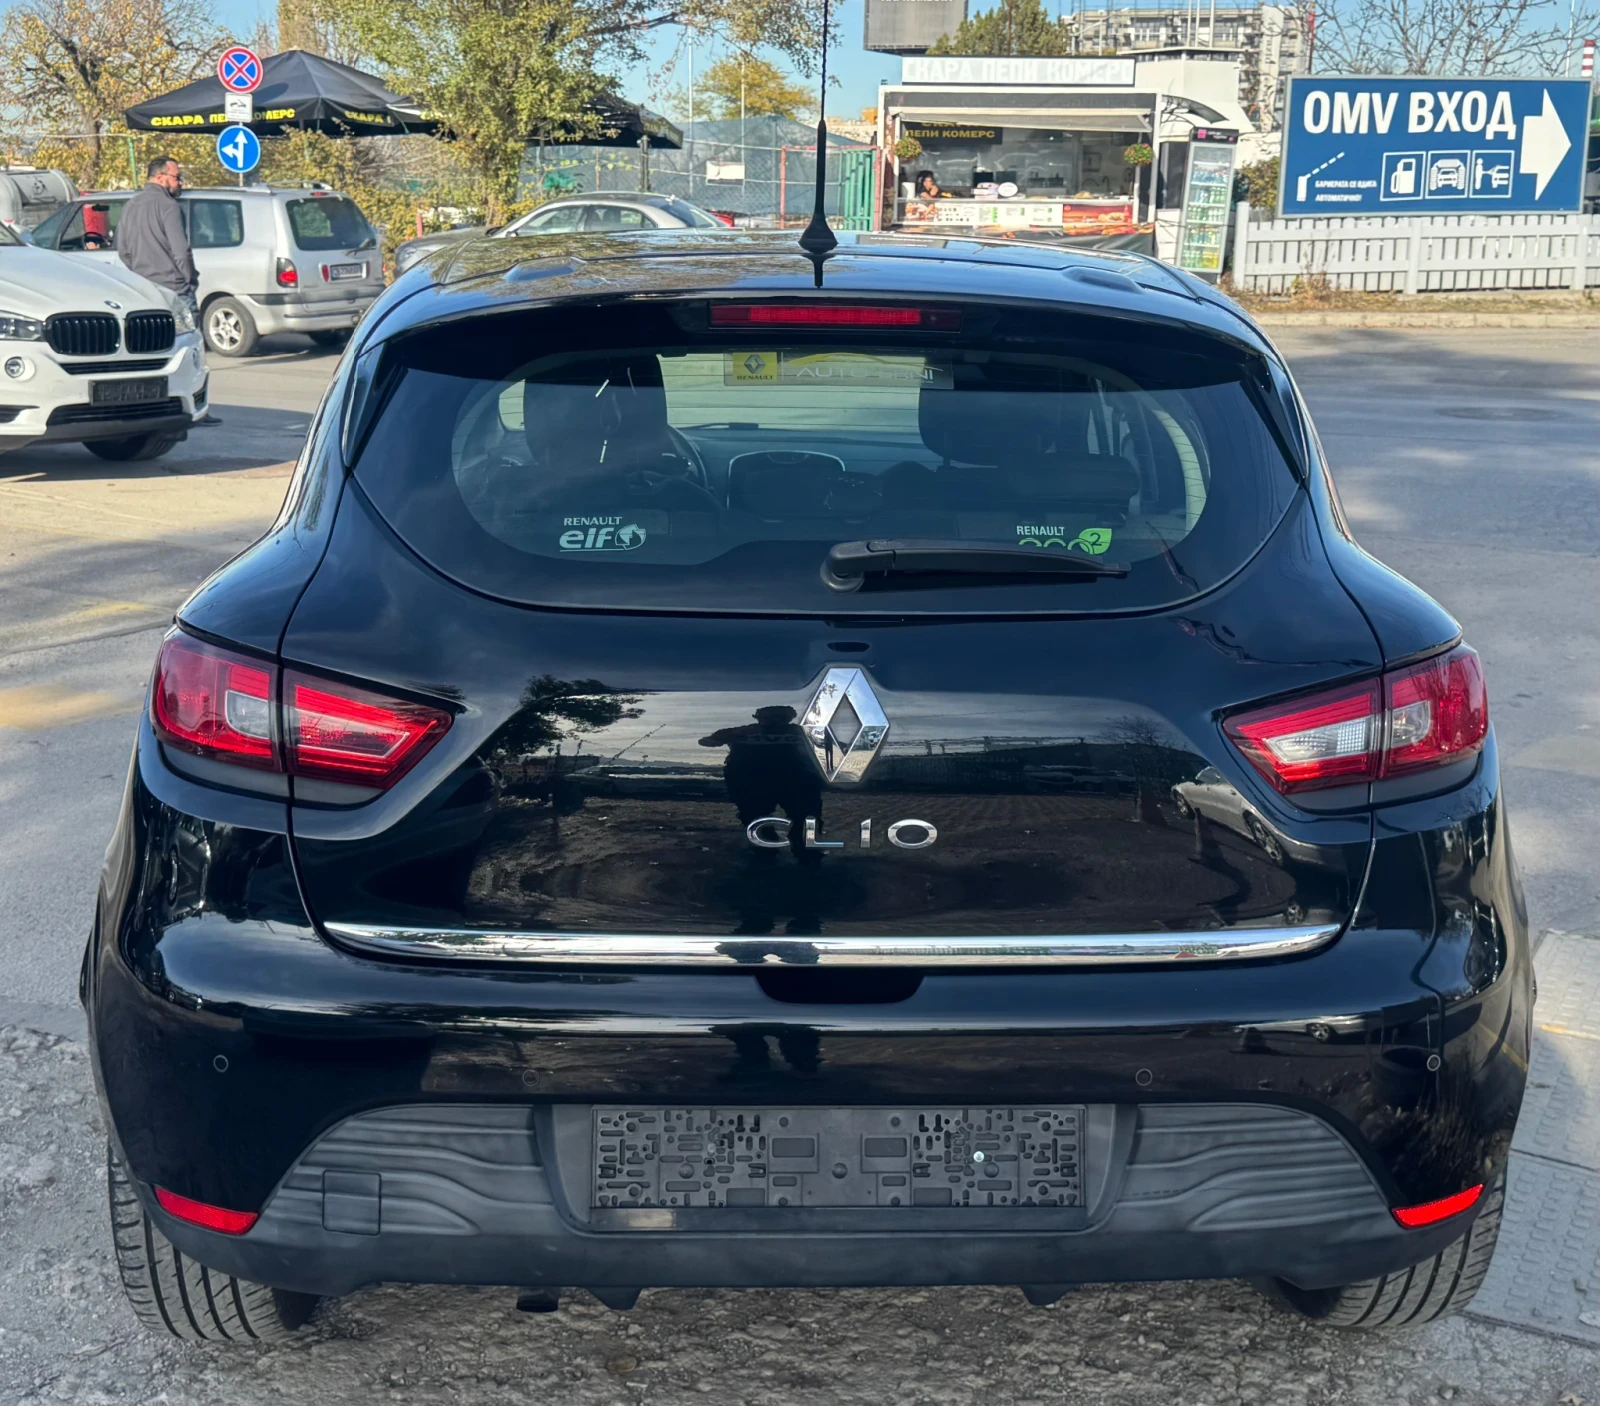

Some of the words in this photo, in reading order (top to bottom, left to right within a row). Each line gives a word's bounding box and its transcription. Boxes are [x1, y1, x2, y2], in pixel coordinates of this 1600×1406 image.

[904, 58, 974, 82] СКАРА
[982, 59, 1037, 82] ПЕПИ
[1047, 60, 1131, 84] КОМЕРС
[150, 114, 205, 127] СКАРА
[1303, 90, 1399, 134] OMV
[1408, 90, 1517, 140] ВХОД
[905, 129, 939, 138] ПЕПИ
[942, 130, 995, 138] КОМЕРС
[796, 366, 867, 378] AUTO
[563, 516, 623, 526] RENAULT
[1016, 525, 1065, 536] RENAULT
[559, 527, 615, 549] elf
[746, 817, 938, 849] CLIO
